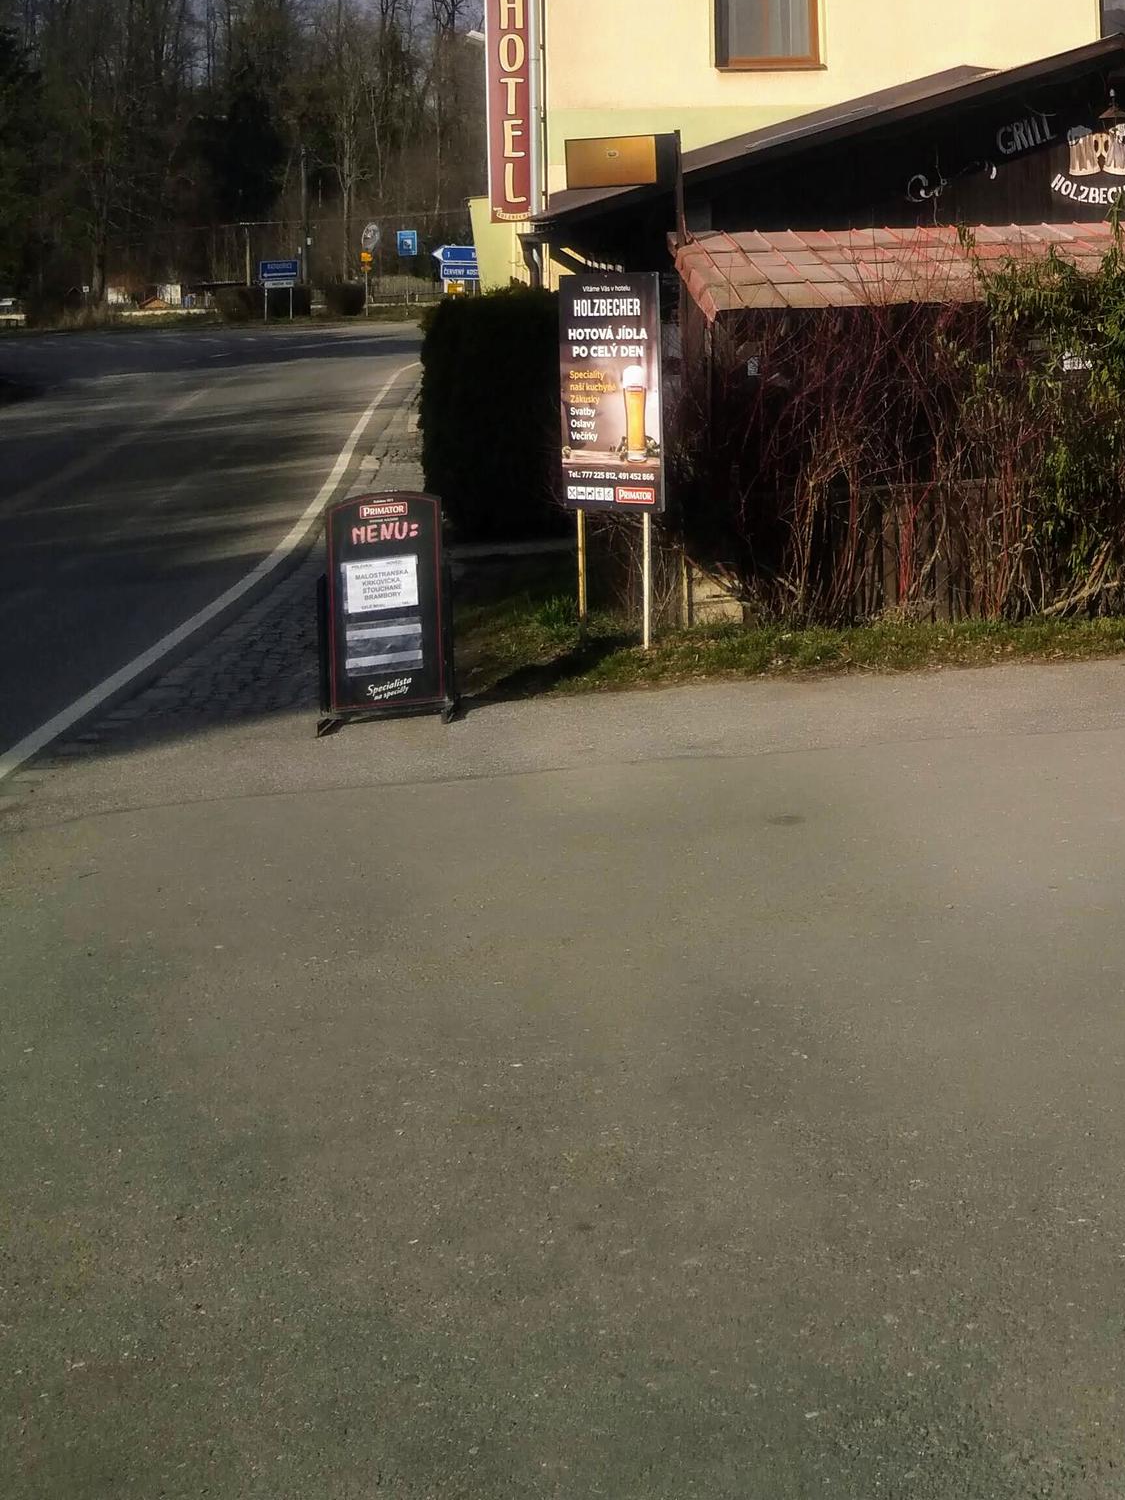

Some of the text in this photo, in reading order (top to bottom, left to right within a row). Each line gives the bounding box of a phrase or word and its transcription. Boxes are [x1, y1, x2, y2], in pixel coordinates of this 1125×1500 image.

[996, 114, 1058, 155] GRILL
[614, 284, 631, 292] hotelu
[573, 298, 641, 317] HOLZBECHER
[568, 325, 648, 340] HOTOVÁ JÍDLA
[572, 343, 644, 357] PO CELÝ DEN
[569, 370, 605, 380] Speciality
[569, 382, 585, 391] naší
[570, 407, 596, 417] Svatby
[570, 419, 596, 429] Oslavy
[571, 431, 598, 442] Večírky
[618, 489, 653, 501] PRIMATOR
[362, 505, 405, 517] PRIMATOR
[351, 521, 419, 545] MENU:
[366, 677, 412, 697] Specialista
